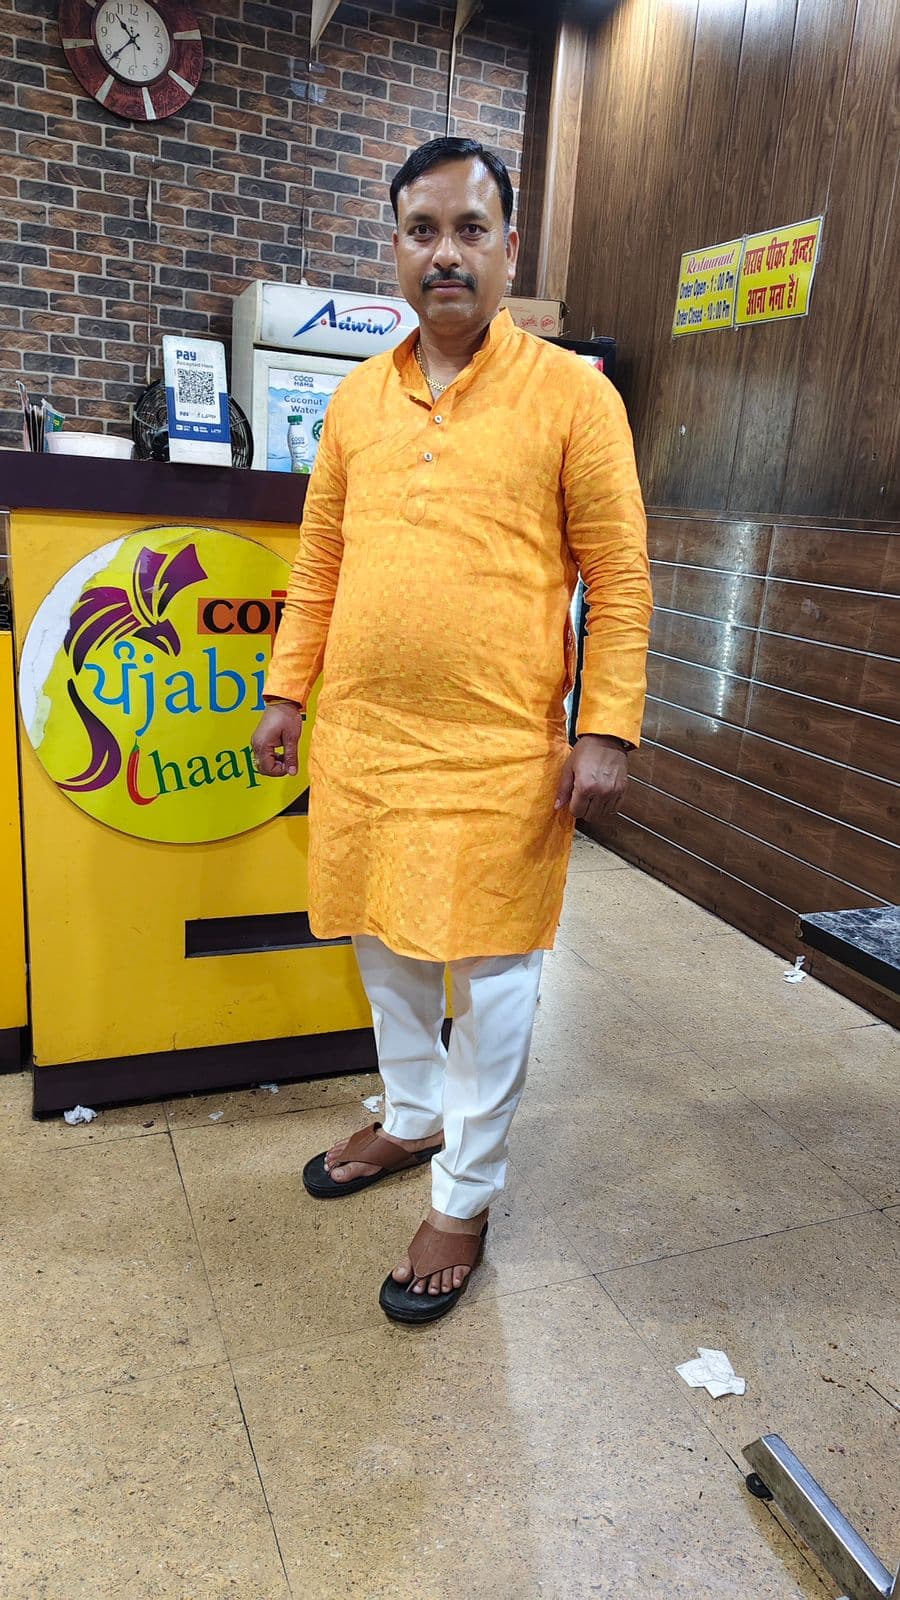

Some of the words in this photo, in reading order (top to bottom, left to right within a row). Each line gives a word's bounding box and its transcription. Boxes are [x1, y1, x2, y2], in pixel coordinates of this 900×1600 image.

[116, 3, 124, 15] 11
[128, 3, 139, 17] 12
[105, 11, 115, 24] 10
[146, 11, 150, 23] 1
[101, 26, 108, 37] 9
[153, 26, 161, 38] 2
[105, 43, 113, 55] 8
[156, 42, 163, 54] 3
[152, 57, 160, 68] 4
[128, 64, 135, 76] 6
[142, 64, 149, 77] 5
[766, 236, 789, 271] पीकर
[789, 234, 817, 266] अन्दर
[686, 248, 736, 275] Restaurant
[679, 282, 694, 299] Order
[694, 278, 707, 299] Open
[746, 287, 768, 315] आना
[768, 283, 787, 312] मना
[292, 299, 396, 336] Adwin
[676, 309, 689, 326] Order
[284, 395, 323, 406] Coconut
[291, 405, 319, 415] Water
